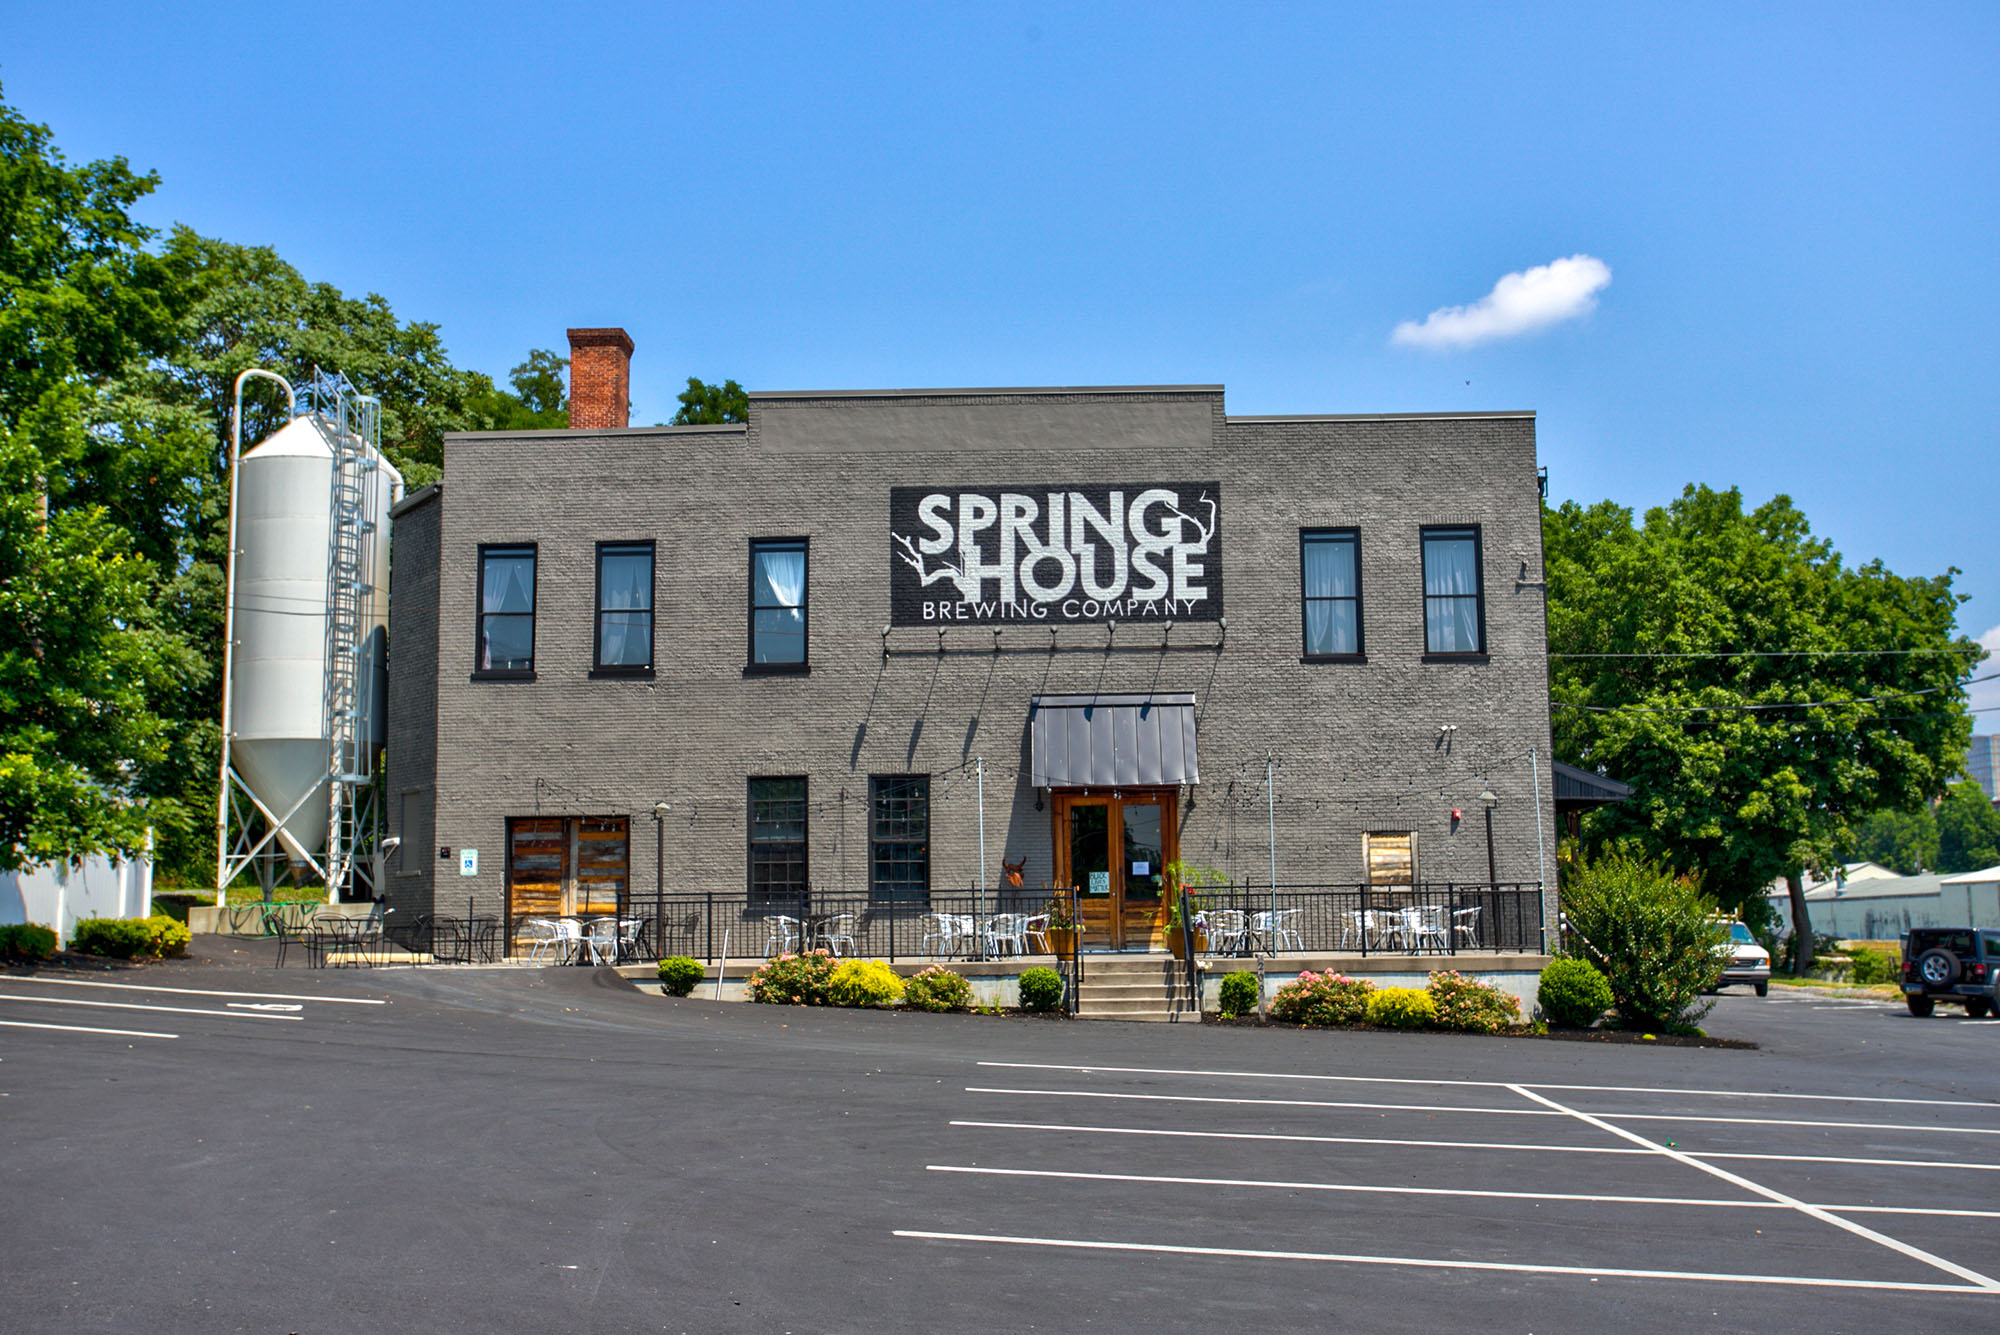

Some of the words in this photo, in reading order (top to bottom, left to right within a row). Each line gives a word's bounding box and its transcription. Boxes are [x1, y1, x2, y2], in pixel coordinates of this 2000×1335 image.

[918, 489, 1182, 554] SPRING
[960, 543, 1208, 604] HOUSE
[922, 600, 1048, 620] BREWING
[1062, 599, 1198, 618] COMPANY
